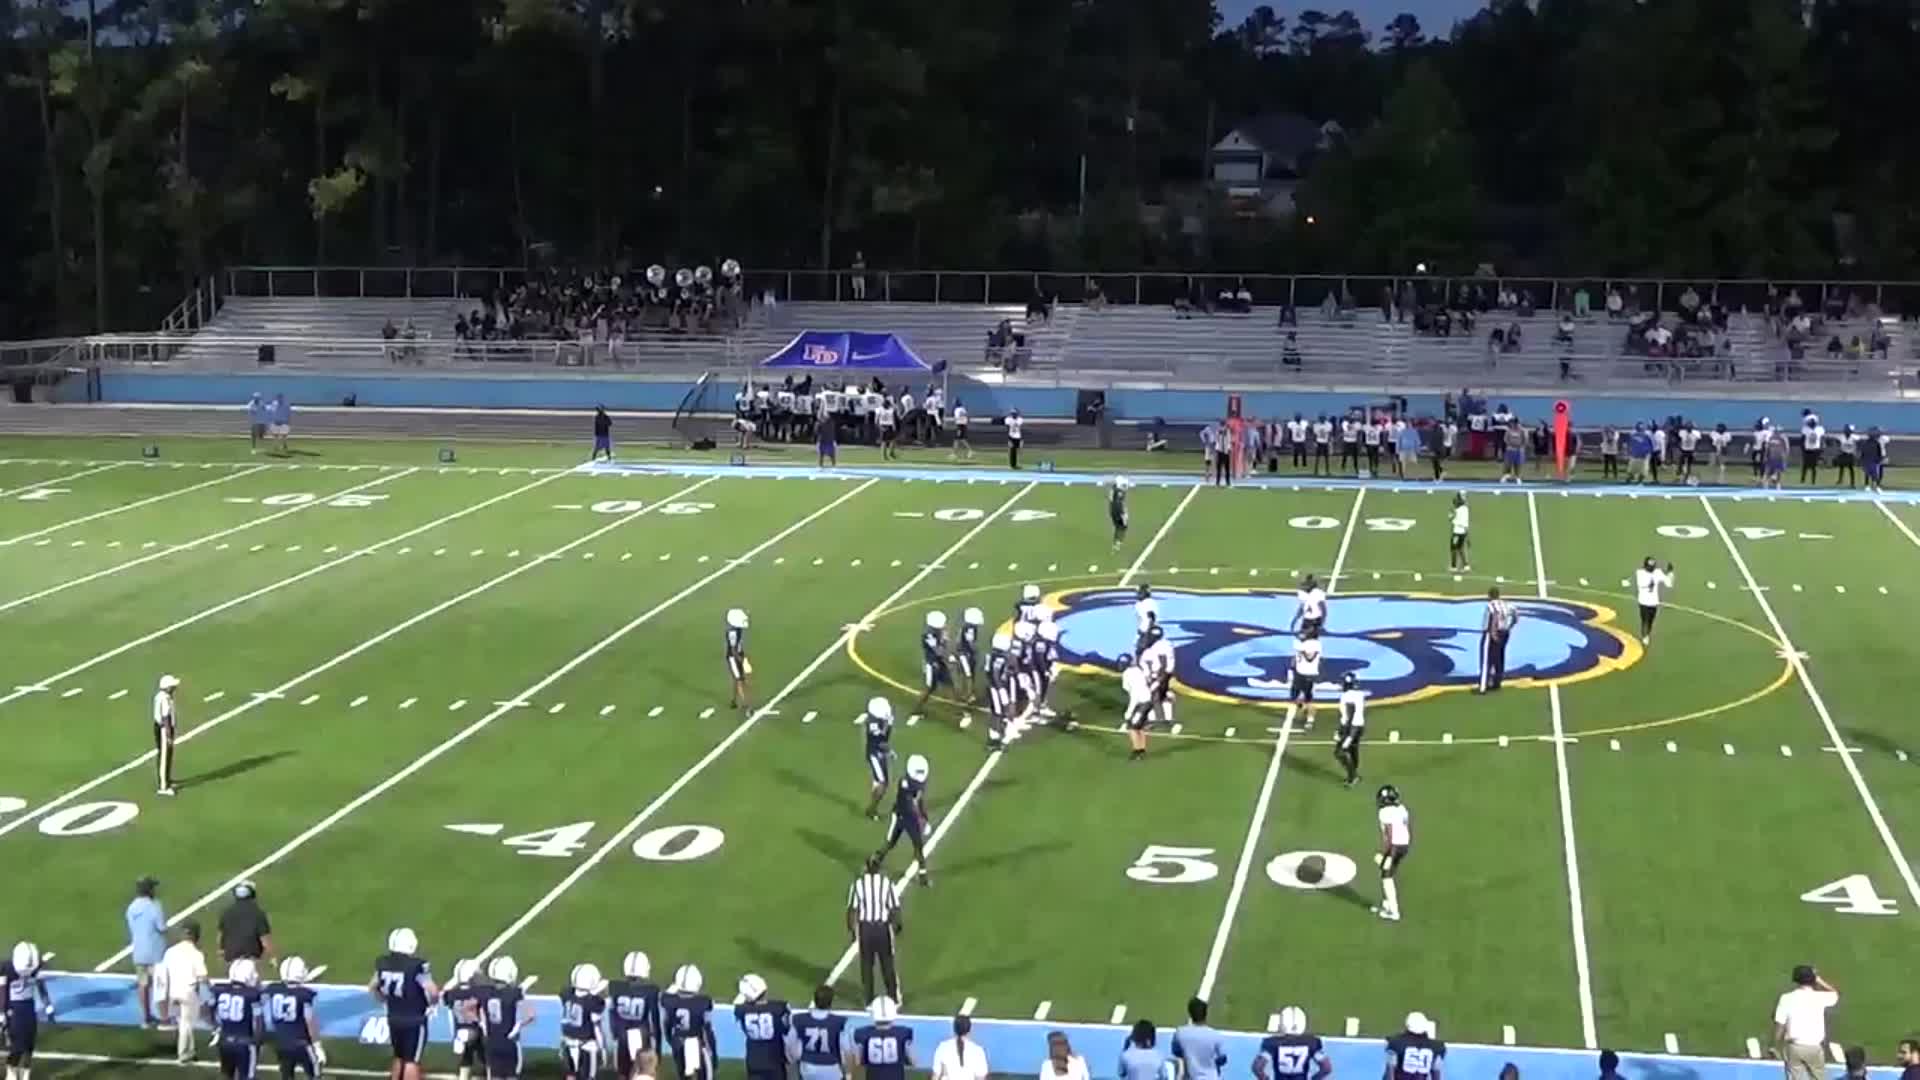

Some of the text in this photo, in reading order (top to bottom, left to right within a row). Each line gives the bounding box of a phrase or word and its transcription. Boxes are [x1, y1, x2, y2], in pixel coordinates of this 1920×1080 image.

[1126, 845, 1357, 889] 50
[380, 970, 405, 998] 77
[804, 1026, 831, 1053] 71
[1278, 1045, 1310, 1075] 57
